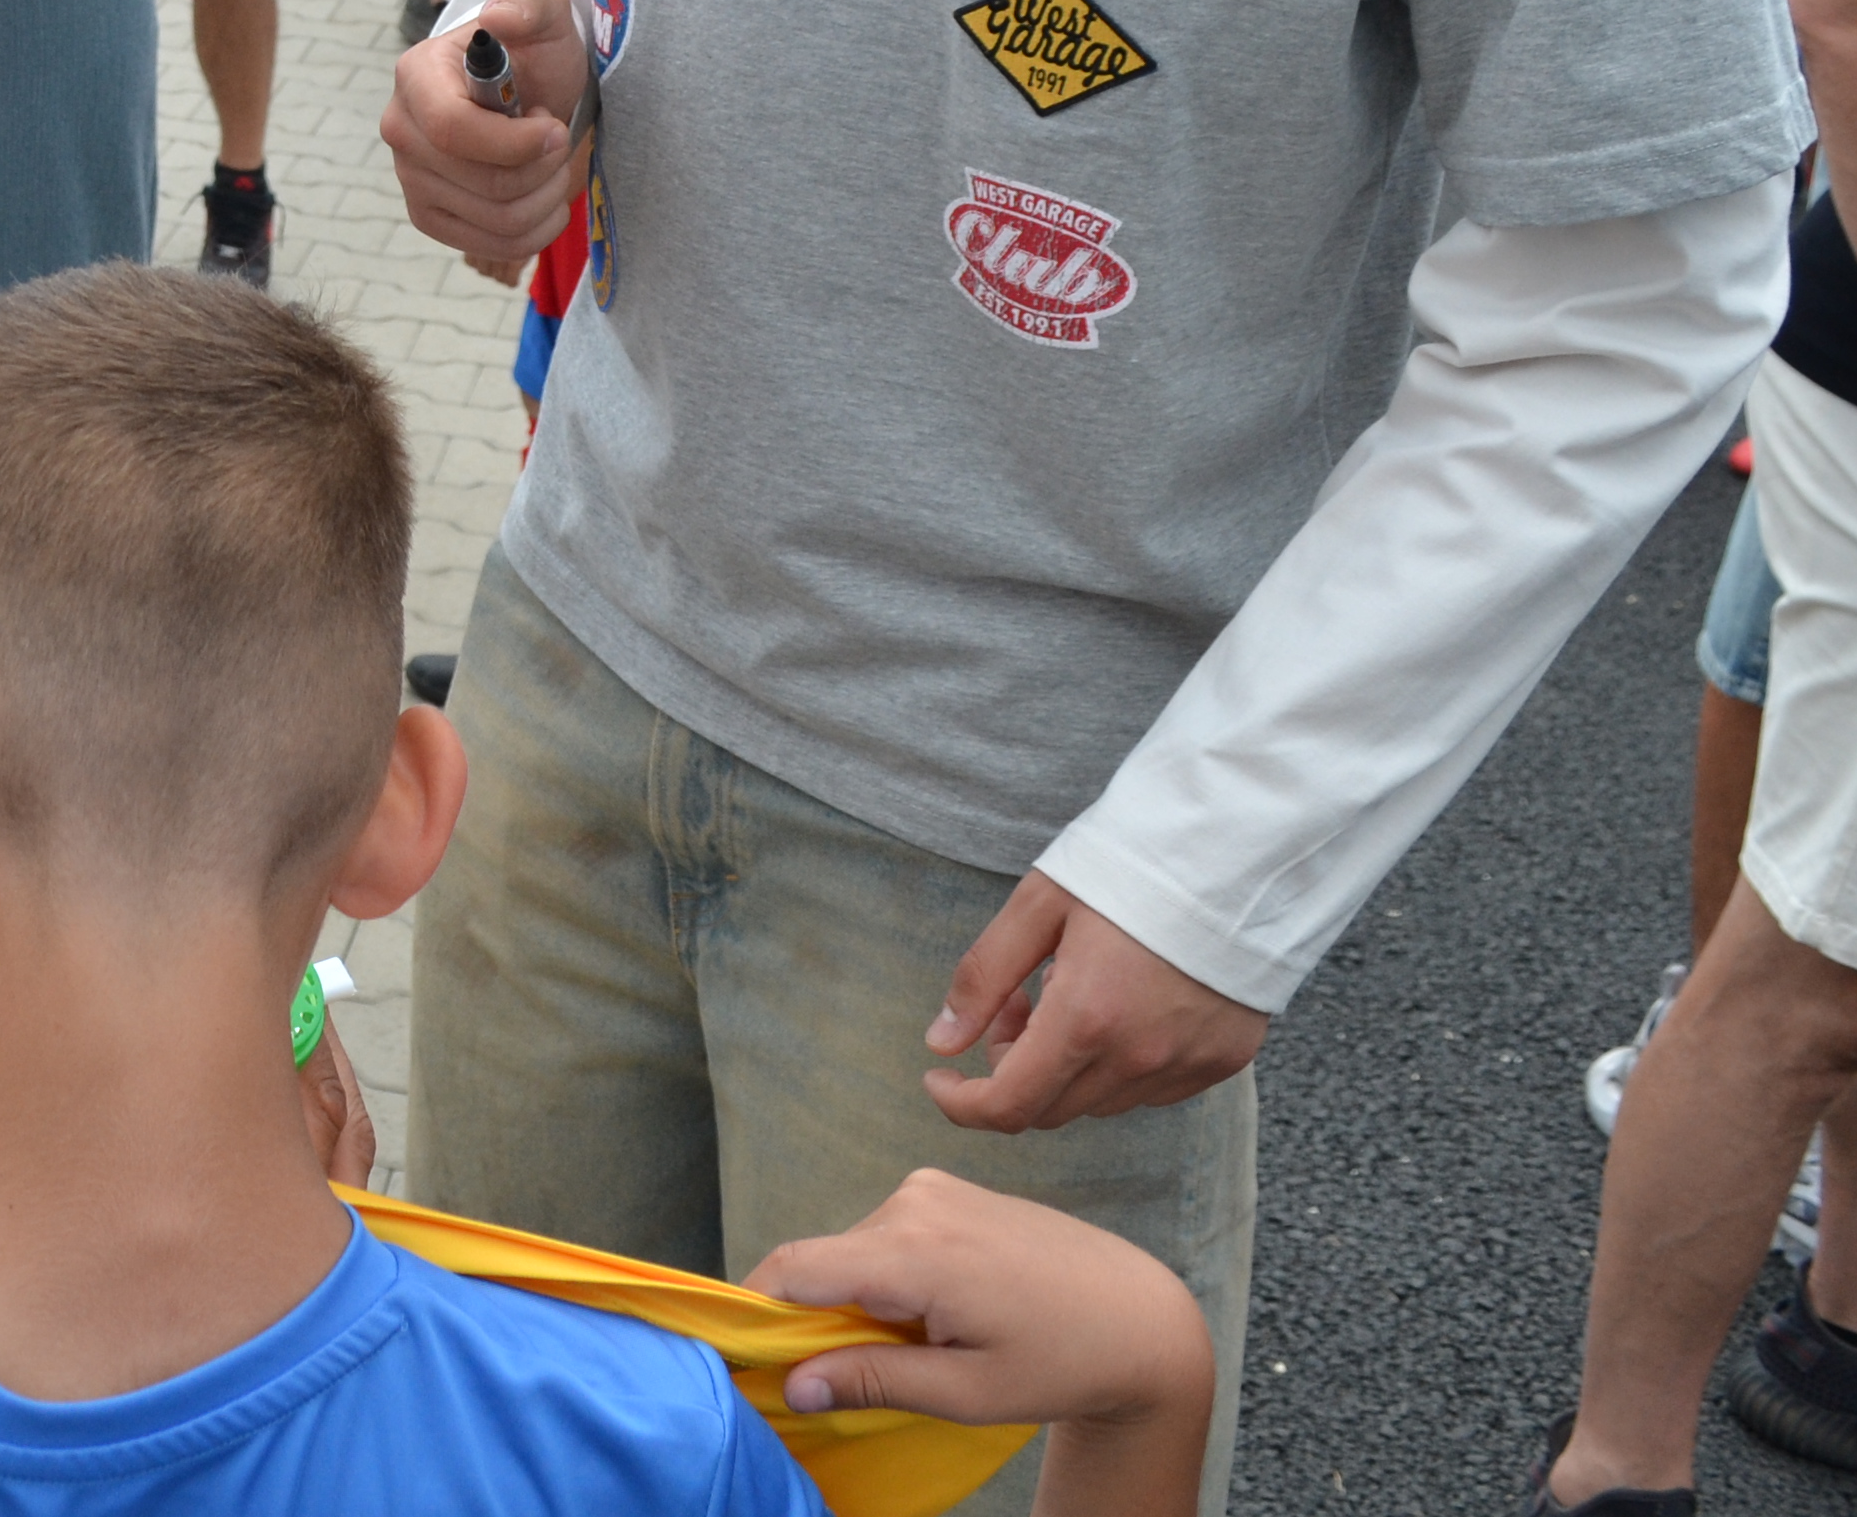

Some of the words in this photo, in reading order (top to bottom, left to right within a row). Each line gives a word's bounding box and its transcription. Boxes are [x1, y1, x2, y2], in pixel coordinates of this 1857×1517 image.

[1027, 65, 1067, 96] 1991
[974, 180, 1019, 208] WEST
[1020, 194, 1104, 239] GARAGE
[955, 210, 1120, 304] Club
